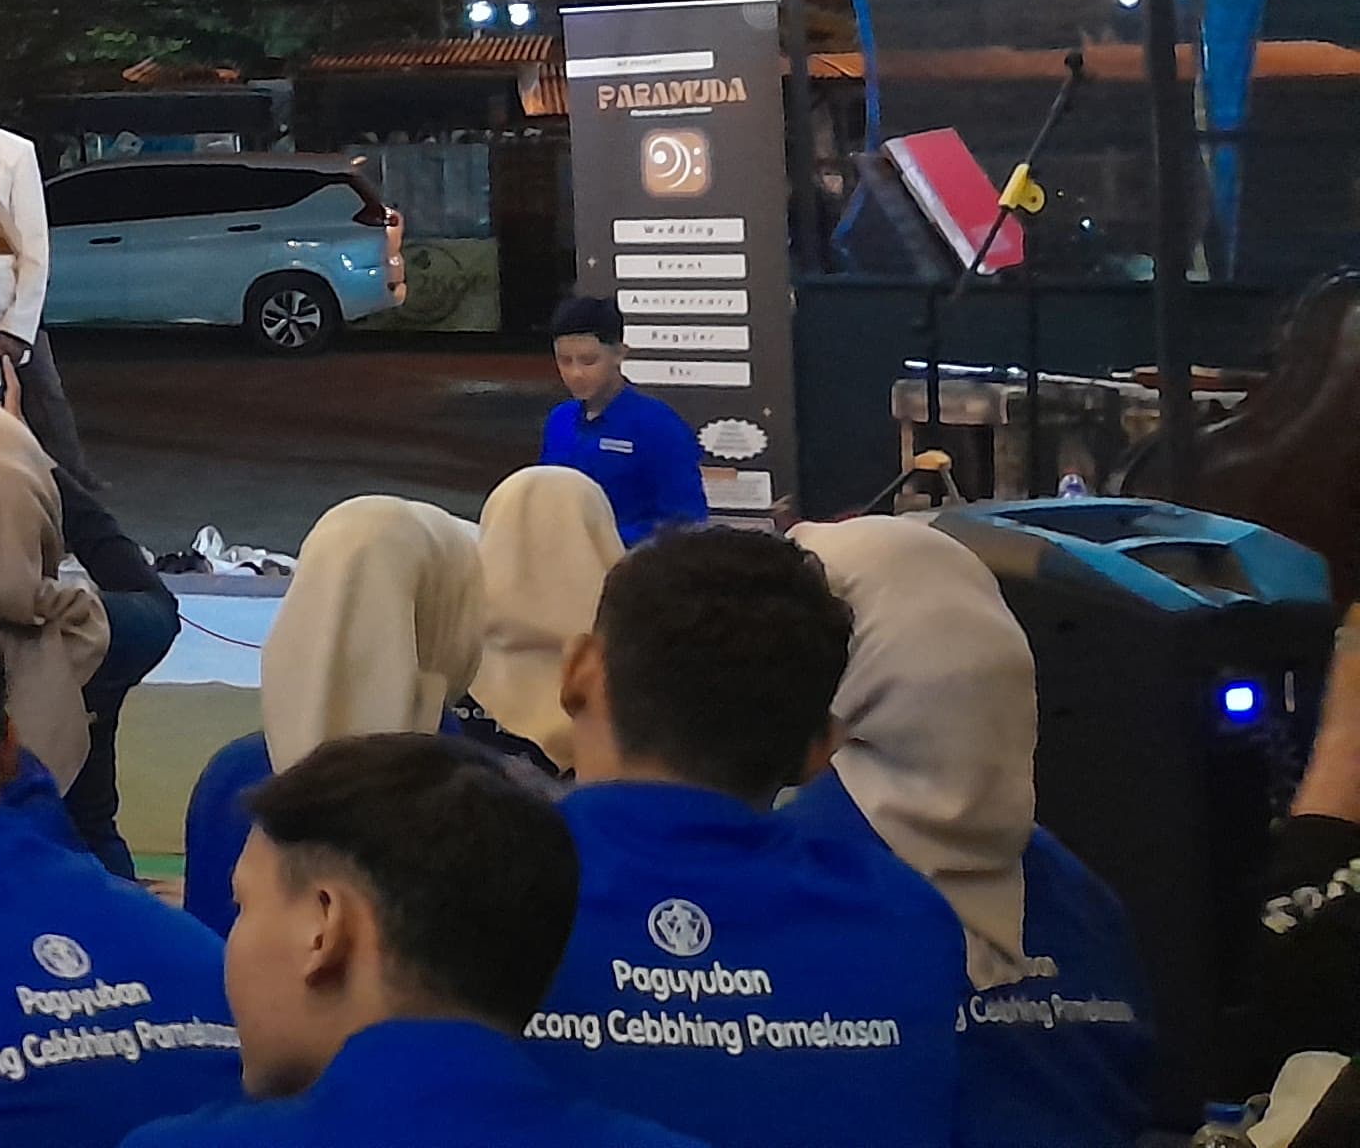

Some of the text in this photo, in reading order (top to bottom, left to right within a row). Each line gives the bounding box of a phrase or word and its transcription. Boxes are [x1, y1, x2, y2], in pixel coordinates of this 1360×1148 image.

[643, 224, 715, 237] Wedding
[657, 260, 704, 270] Event
[631, 295, 734, 308] Anniversary
[15, 978, 153, 1021] Paguyuban
[612, 959, 773, 1003] Paguyuban
[22, 1025, 141, 1062] Cebbhing
[606, 1009, 743, 1055] Cebbhing
[747, 1011, 902, 1047] Pamekasan
